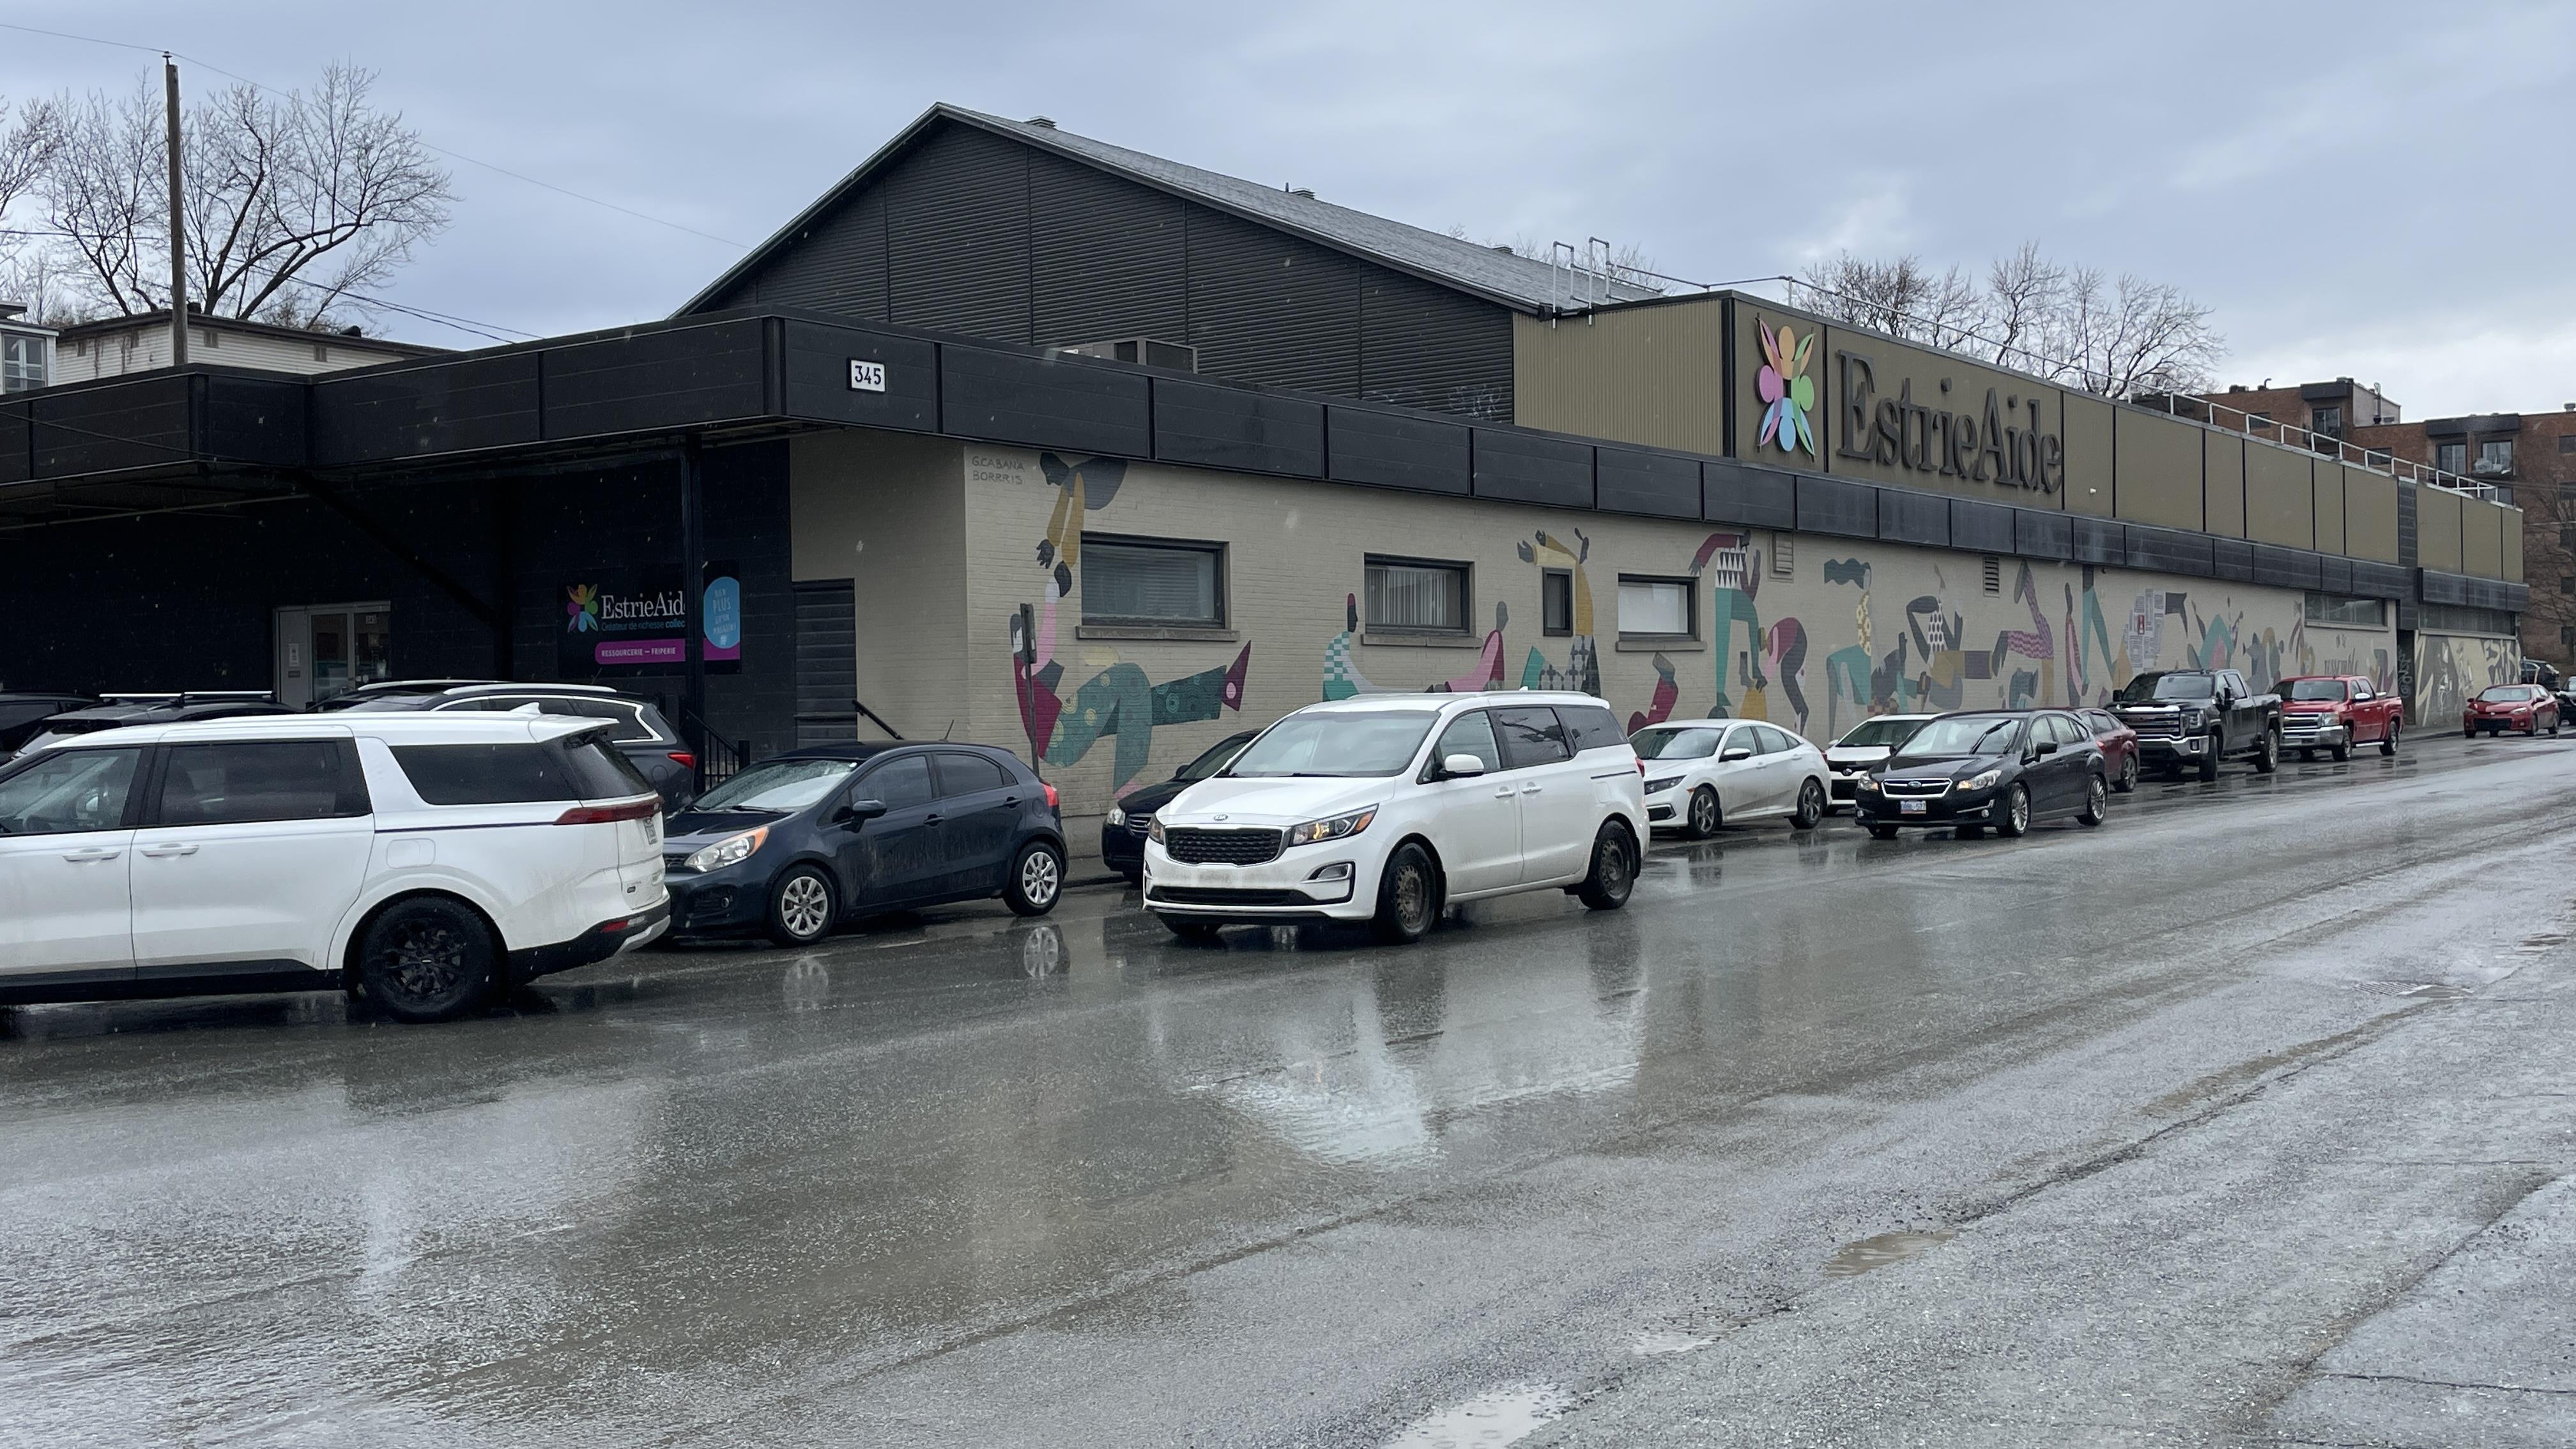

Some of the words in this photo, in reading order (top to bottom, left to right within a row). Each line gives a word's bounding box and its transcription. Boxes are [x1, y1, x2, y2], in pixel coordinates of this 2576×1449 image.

[854, 365, 882, 385] 345
[1836, 349, 2062, 494] EstrieAide
[601, 590, 685, 619] EstrieAid
[713, 597, 731, 614] PLUS
[665, 618, 685, 628] collec
[602, 648, 643, 657] RESSOURCERIE
